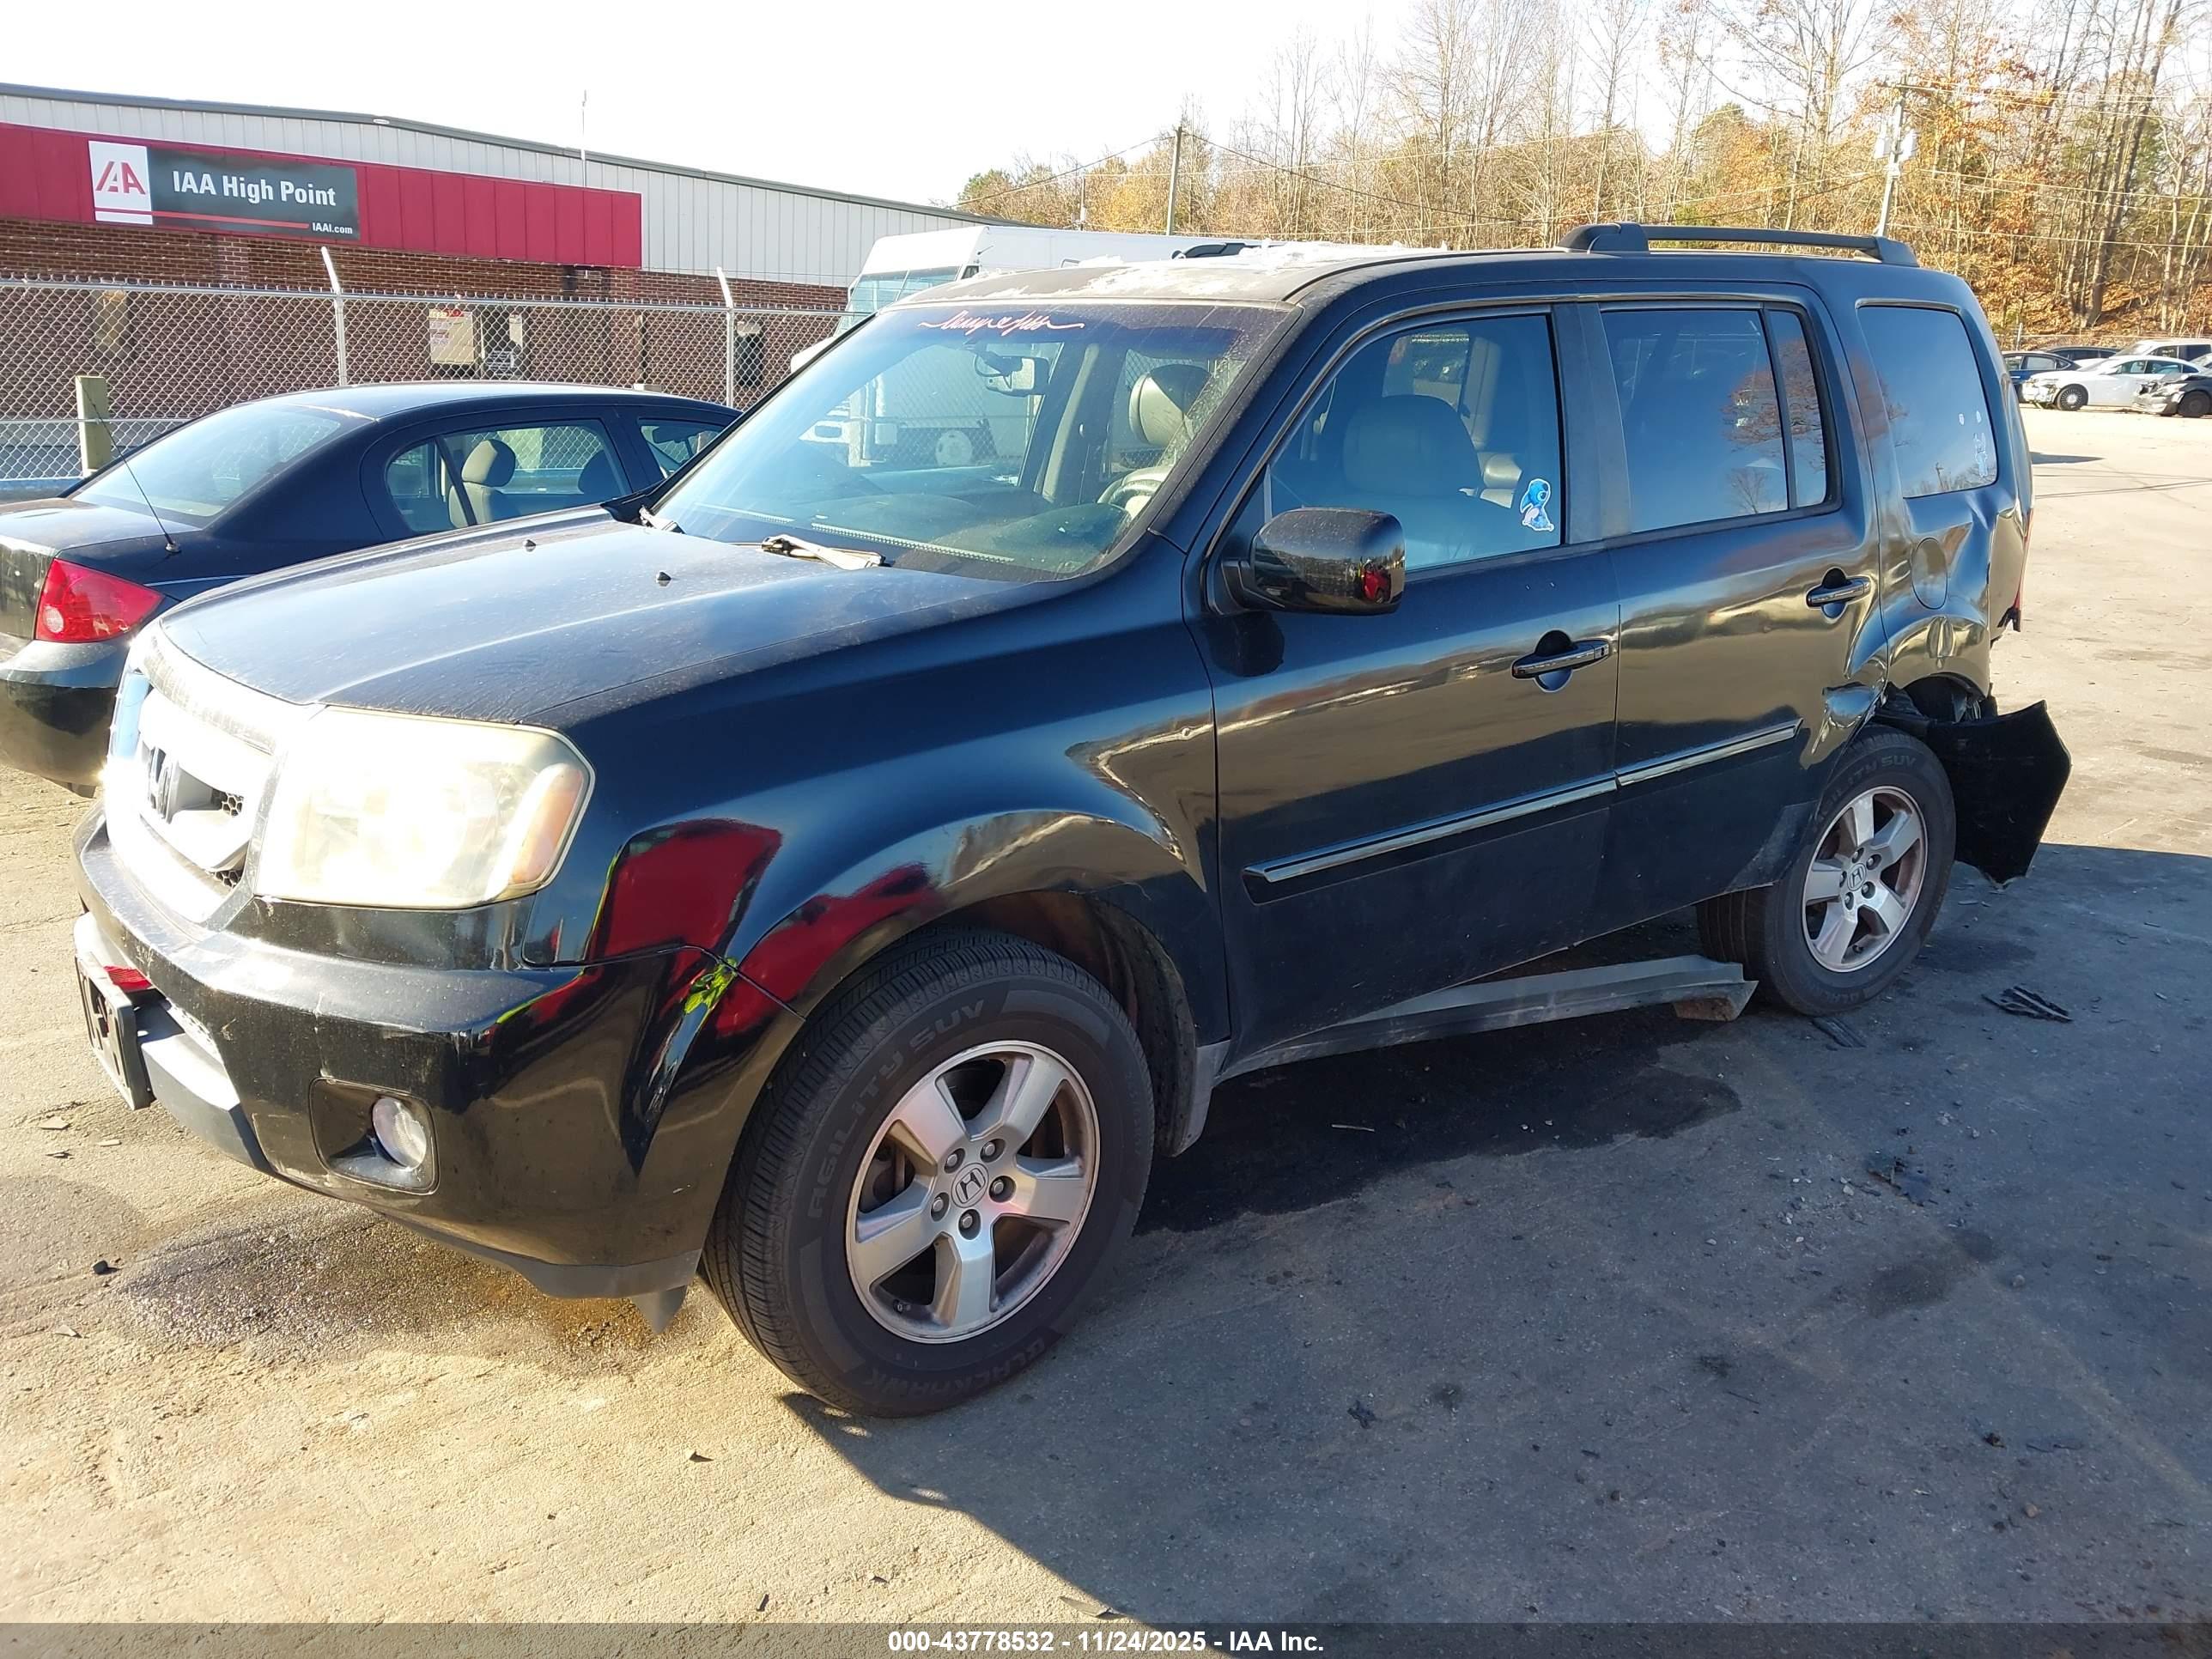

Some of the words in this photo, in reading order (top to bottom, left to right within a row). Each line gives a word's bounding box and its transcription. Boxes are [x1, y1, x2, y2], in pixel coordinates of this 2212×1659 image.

[173, 171, 216, 195] IAA
[222, 175, 274, 204] High
[280, 180, 337, 206] Point
[312, 222, 353, 234] IAAI.com
[1881, 754, 1917, 768] SUV
[808, 1052, 904, 1218] AGILITY
[909, 999, 985, 1052] SUV
